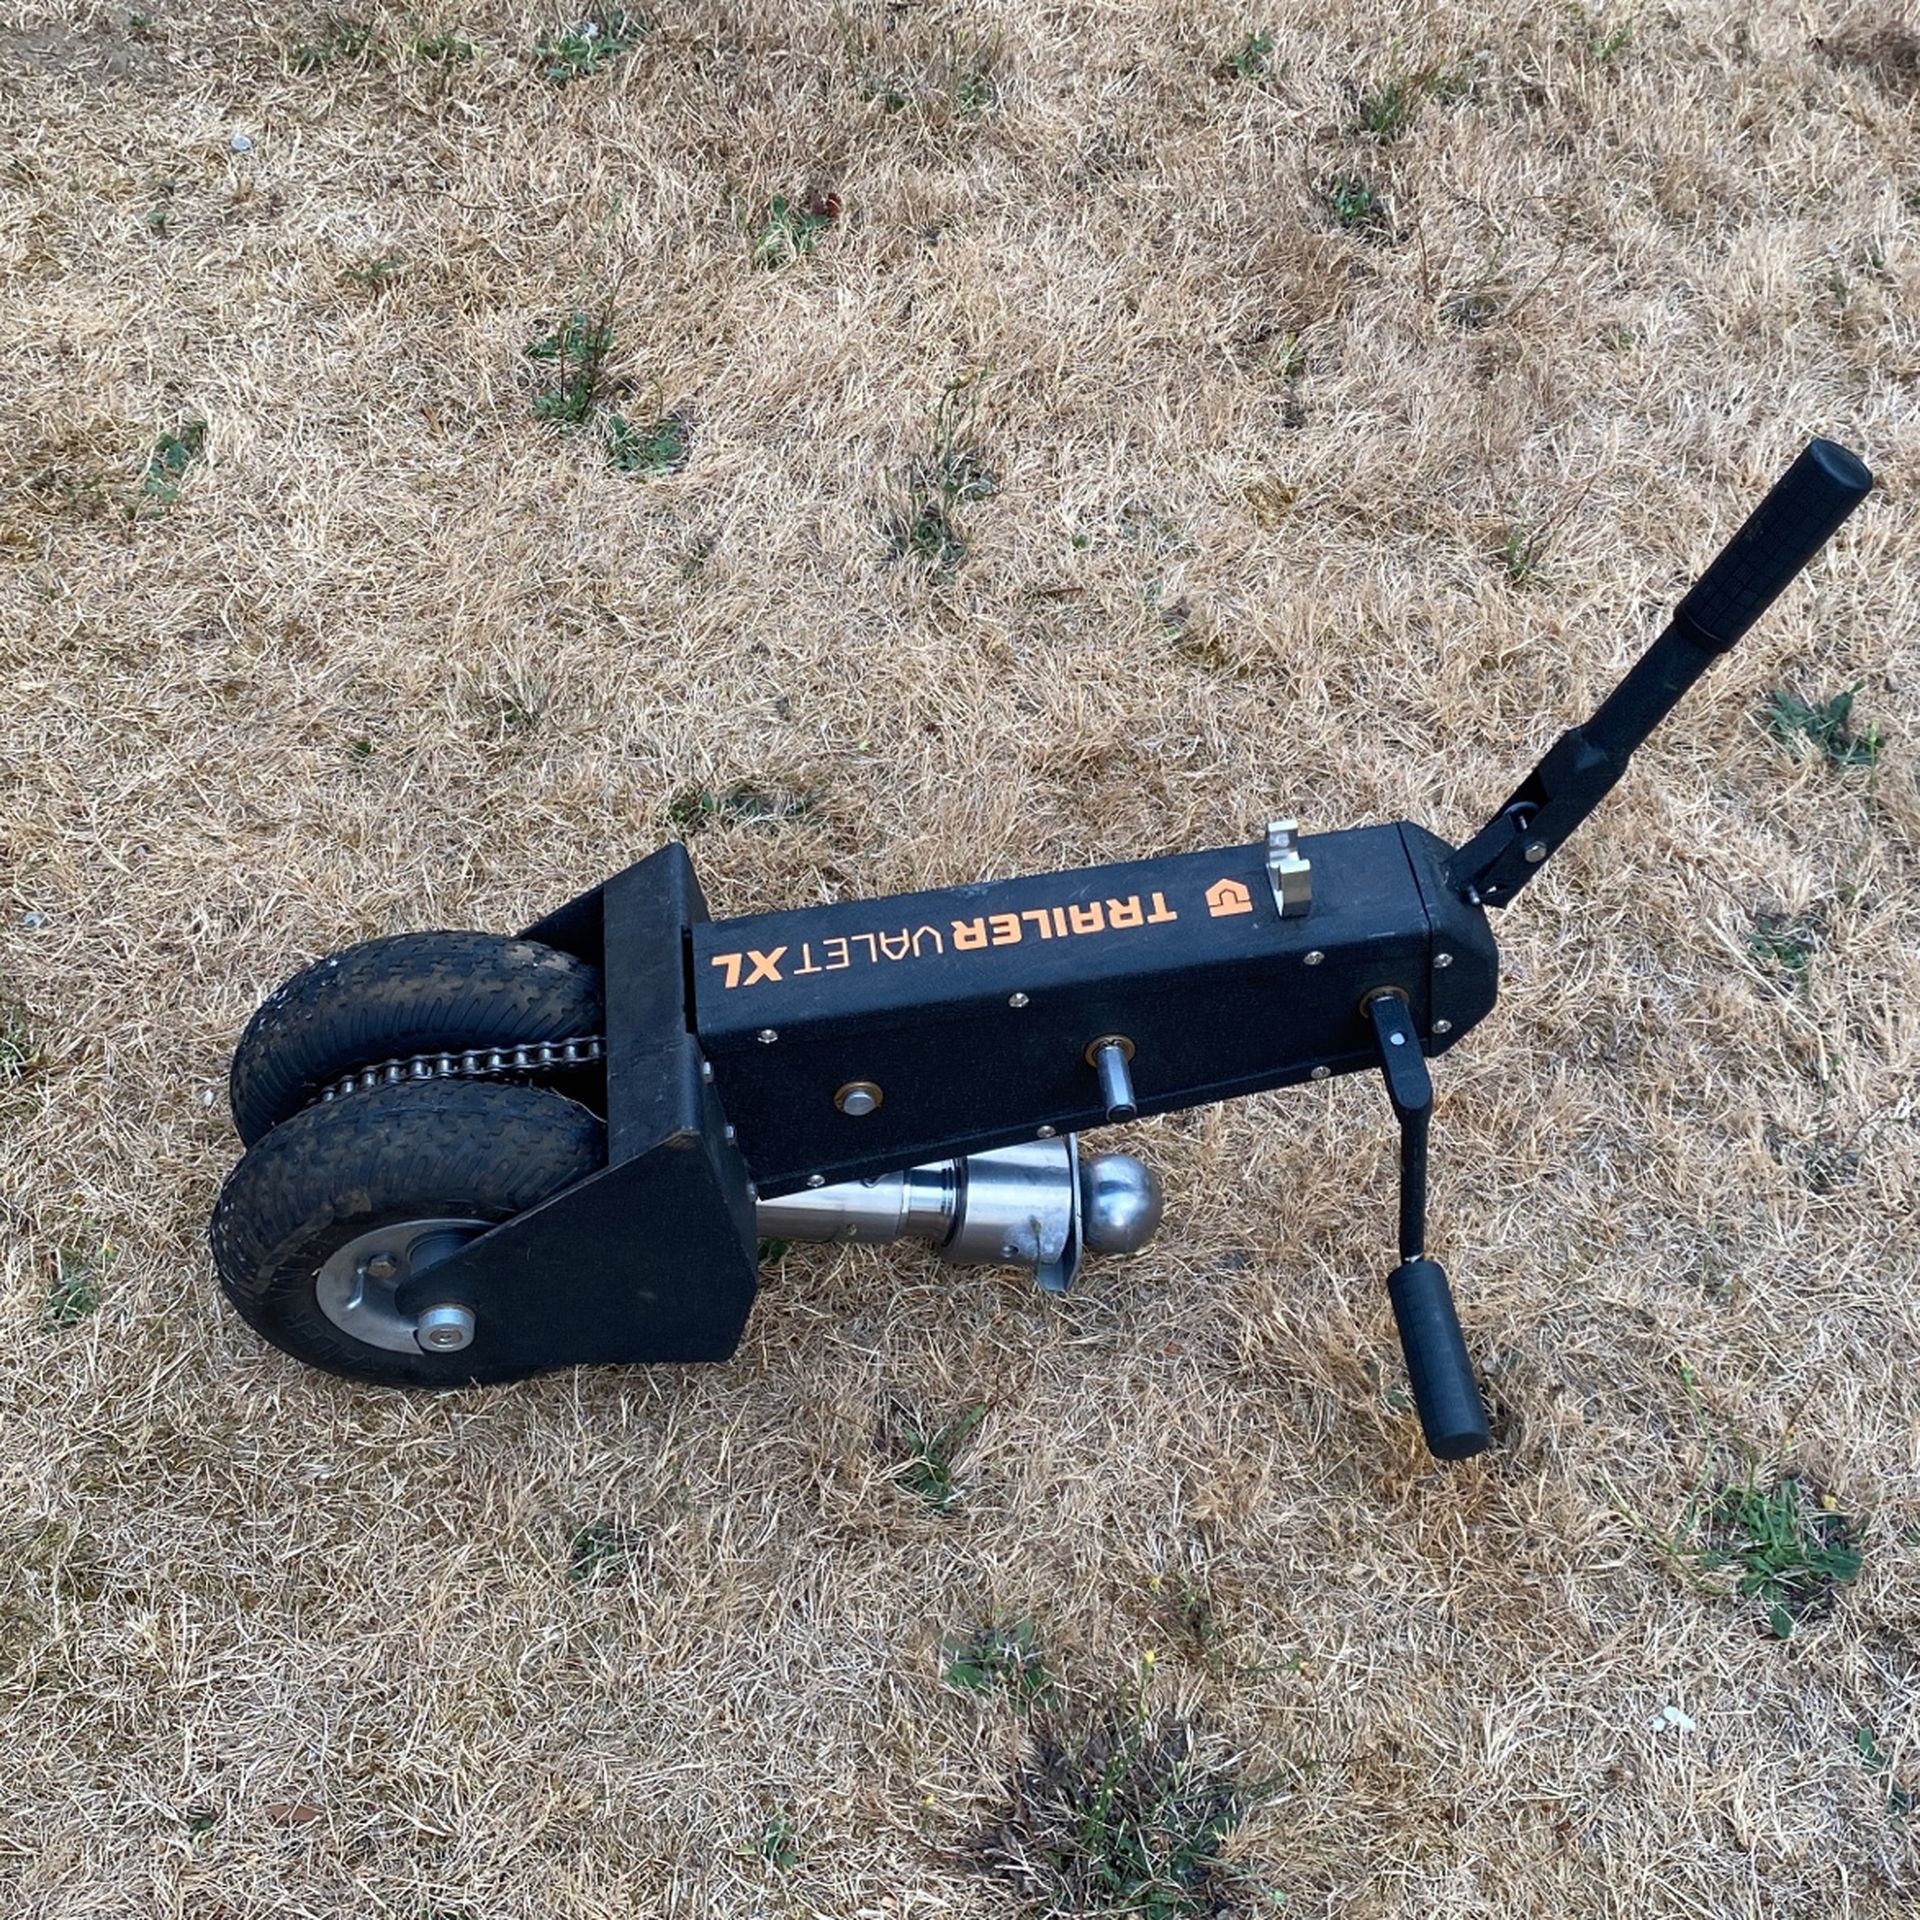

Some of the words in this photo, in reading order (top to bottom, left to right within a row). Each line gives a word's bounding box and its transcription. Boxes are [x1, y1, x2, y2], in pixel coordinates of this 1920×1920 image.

[953, 892, 1177, 950] TRAILER
[712, 947, 787, 988] XL
[793, 925, 943, 974] VALET
